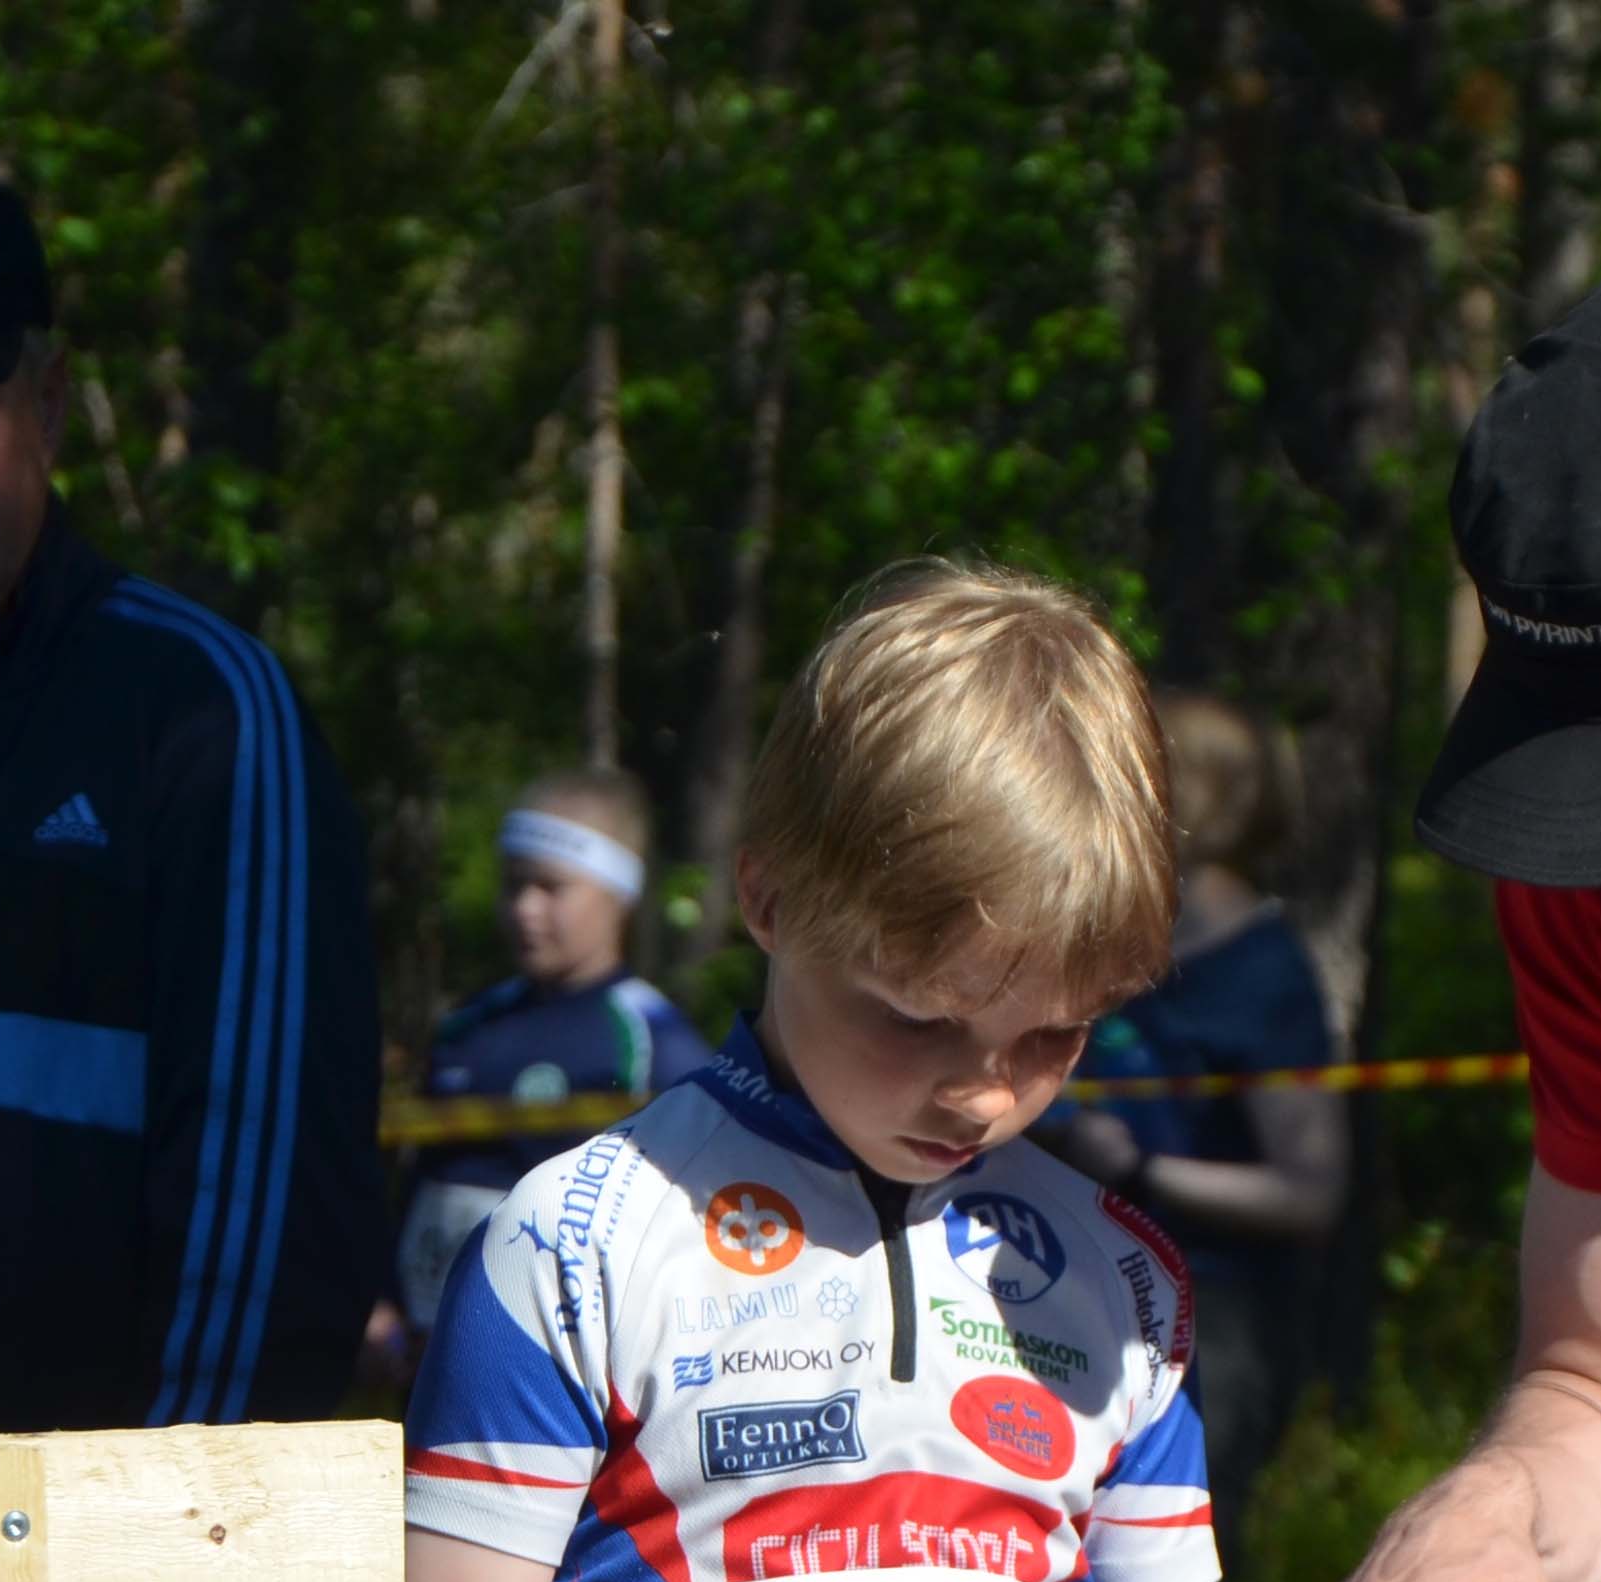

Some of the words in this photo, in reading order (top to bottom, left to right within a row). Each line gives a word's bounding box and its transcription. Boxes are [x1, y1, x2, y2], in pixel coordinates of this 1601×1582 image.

[674, 1282, 800, 1334] LAMU
[720, 1348, 833, 1375] KEMIJOKI
[839, 1339, 876, 1364] OY
[955, 1343, 1071, 1385] ROVANIEMI
[722, 1438, 847, 1471] OPTIIKKA
